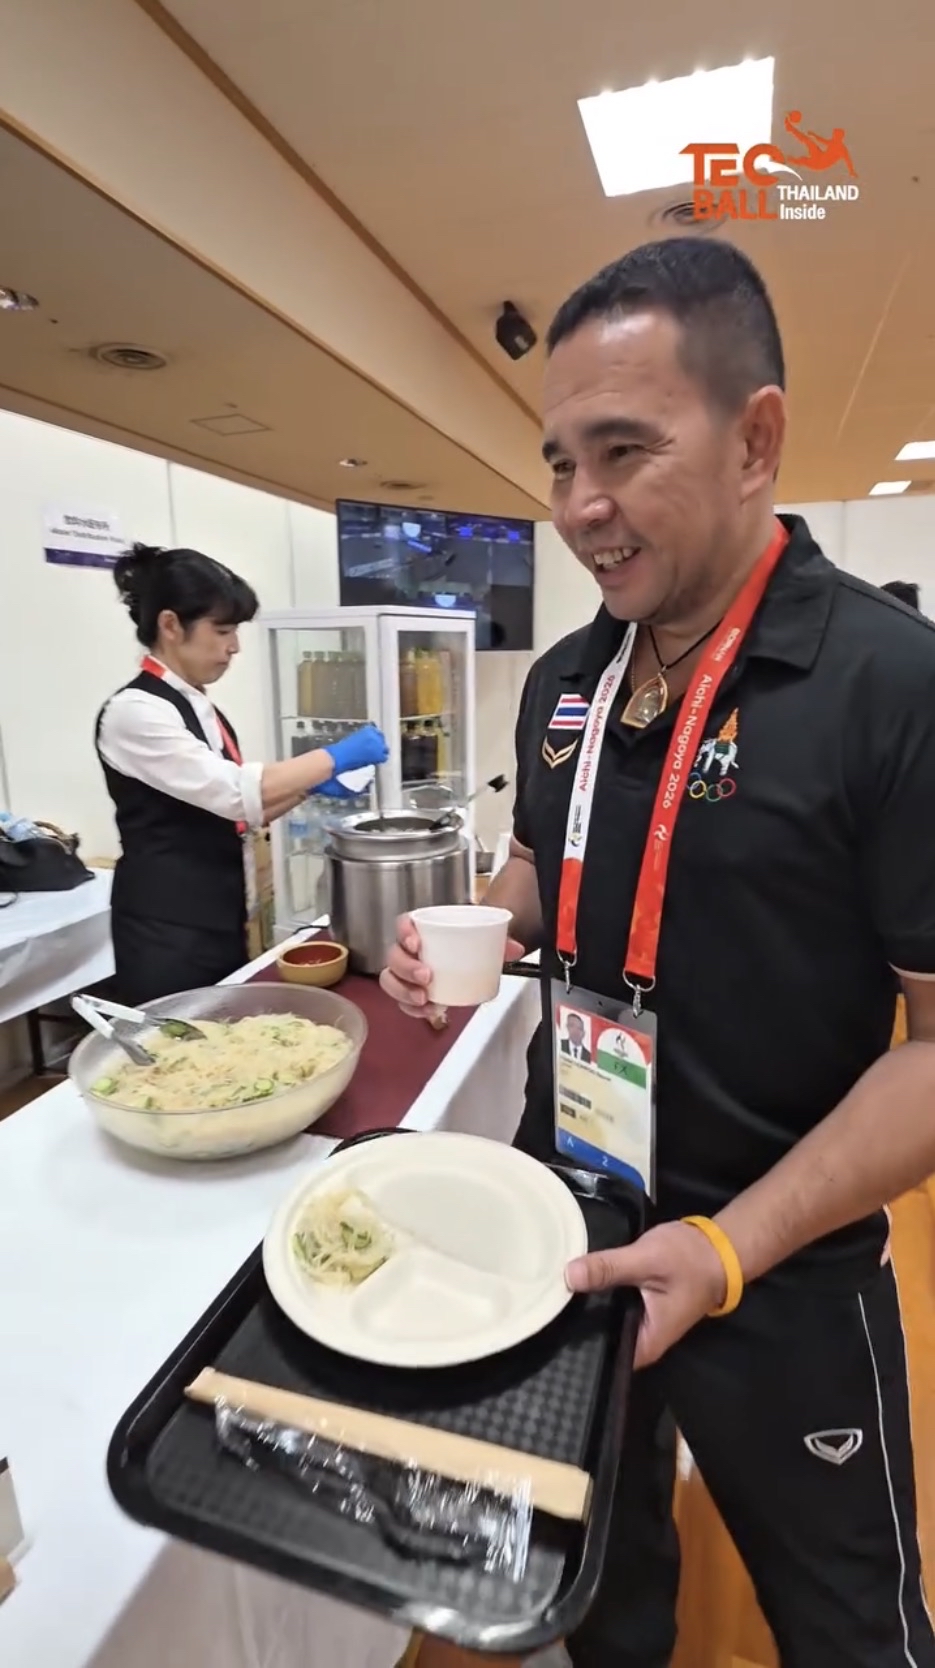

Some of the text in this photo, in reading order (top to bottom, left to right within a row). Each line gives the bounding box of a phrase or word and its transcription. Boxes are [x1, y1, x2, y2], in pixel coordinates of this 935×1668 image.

[578, 674, 616, 792] Aichi-Nagoya 2026
[662, 674, 712, 809] Aichi-Nagoya 2026
[602, 1156, 608, 1167] 2
